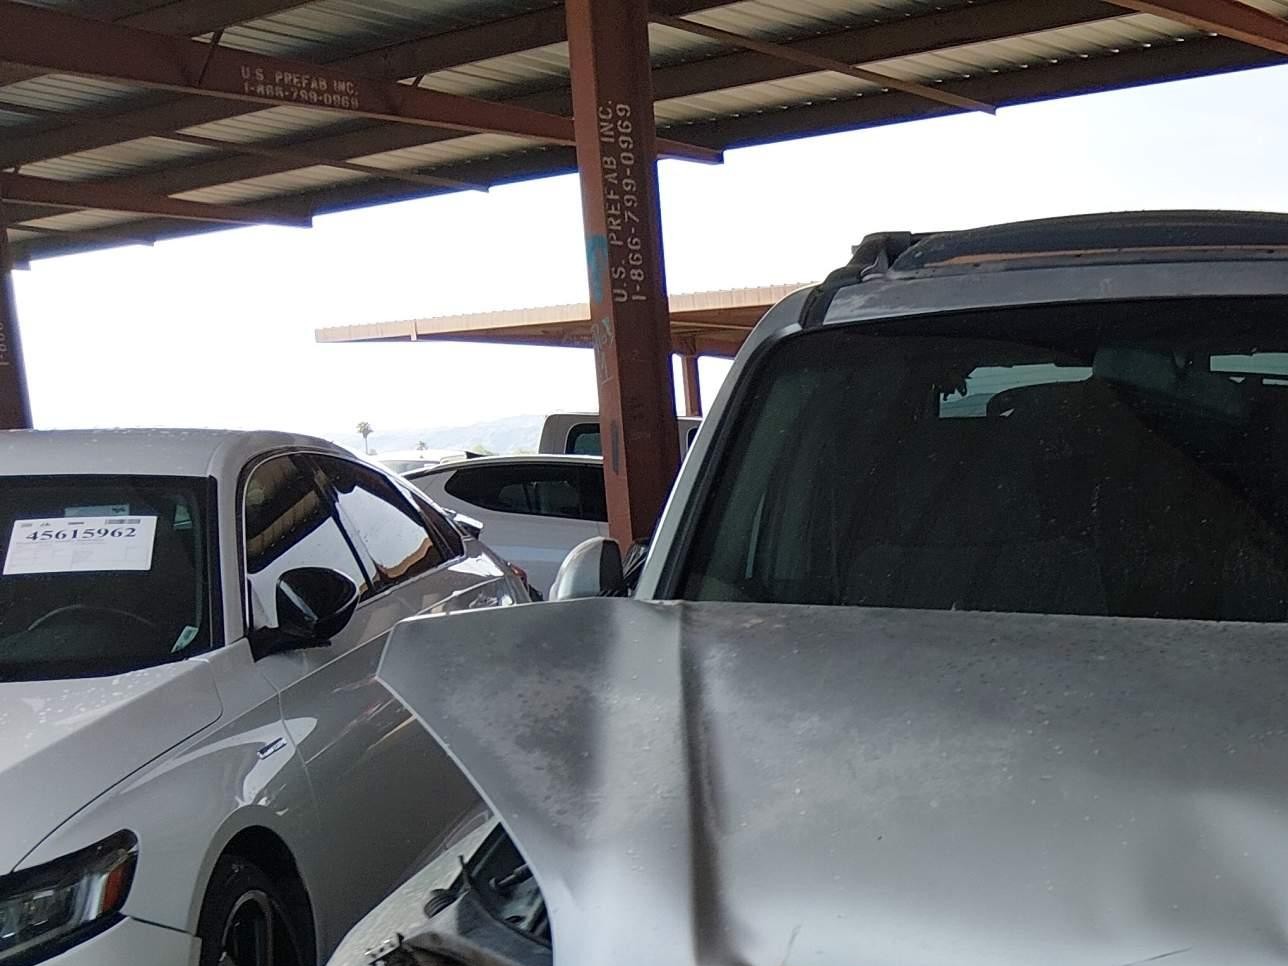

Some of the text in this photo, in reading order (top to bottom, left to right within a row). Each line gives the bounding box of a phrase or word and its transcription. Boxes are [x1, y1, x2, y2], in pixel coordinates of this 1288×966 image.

[275, 71, 328, 91] PREFAB
[599, 99, 629, 303] U.S. PREFAB INC.
[616, 103, 647, 301] 1-866-799-0969
[26, 527, 137, 541] 45615962
